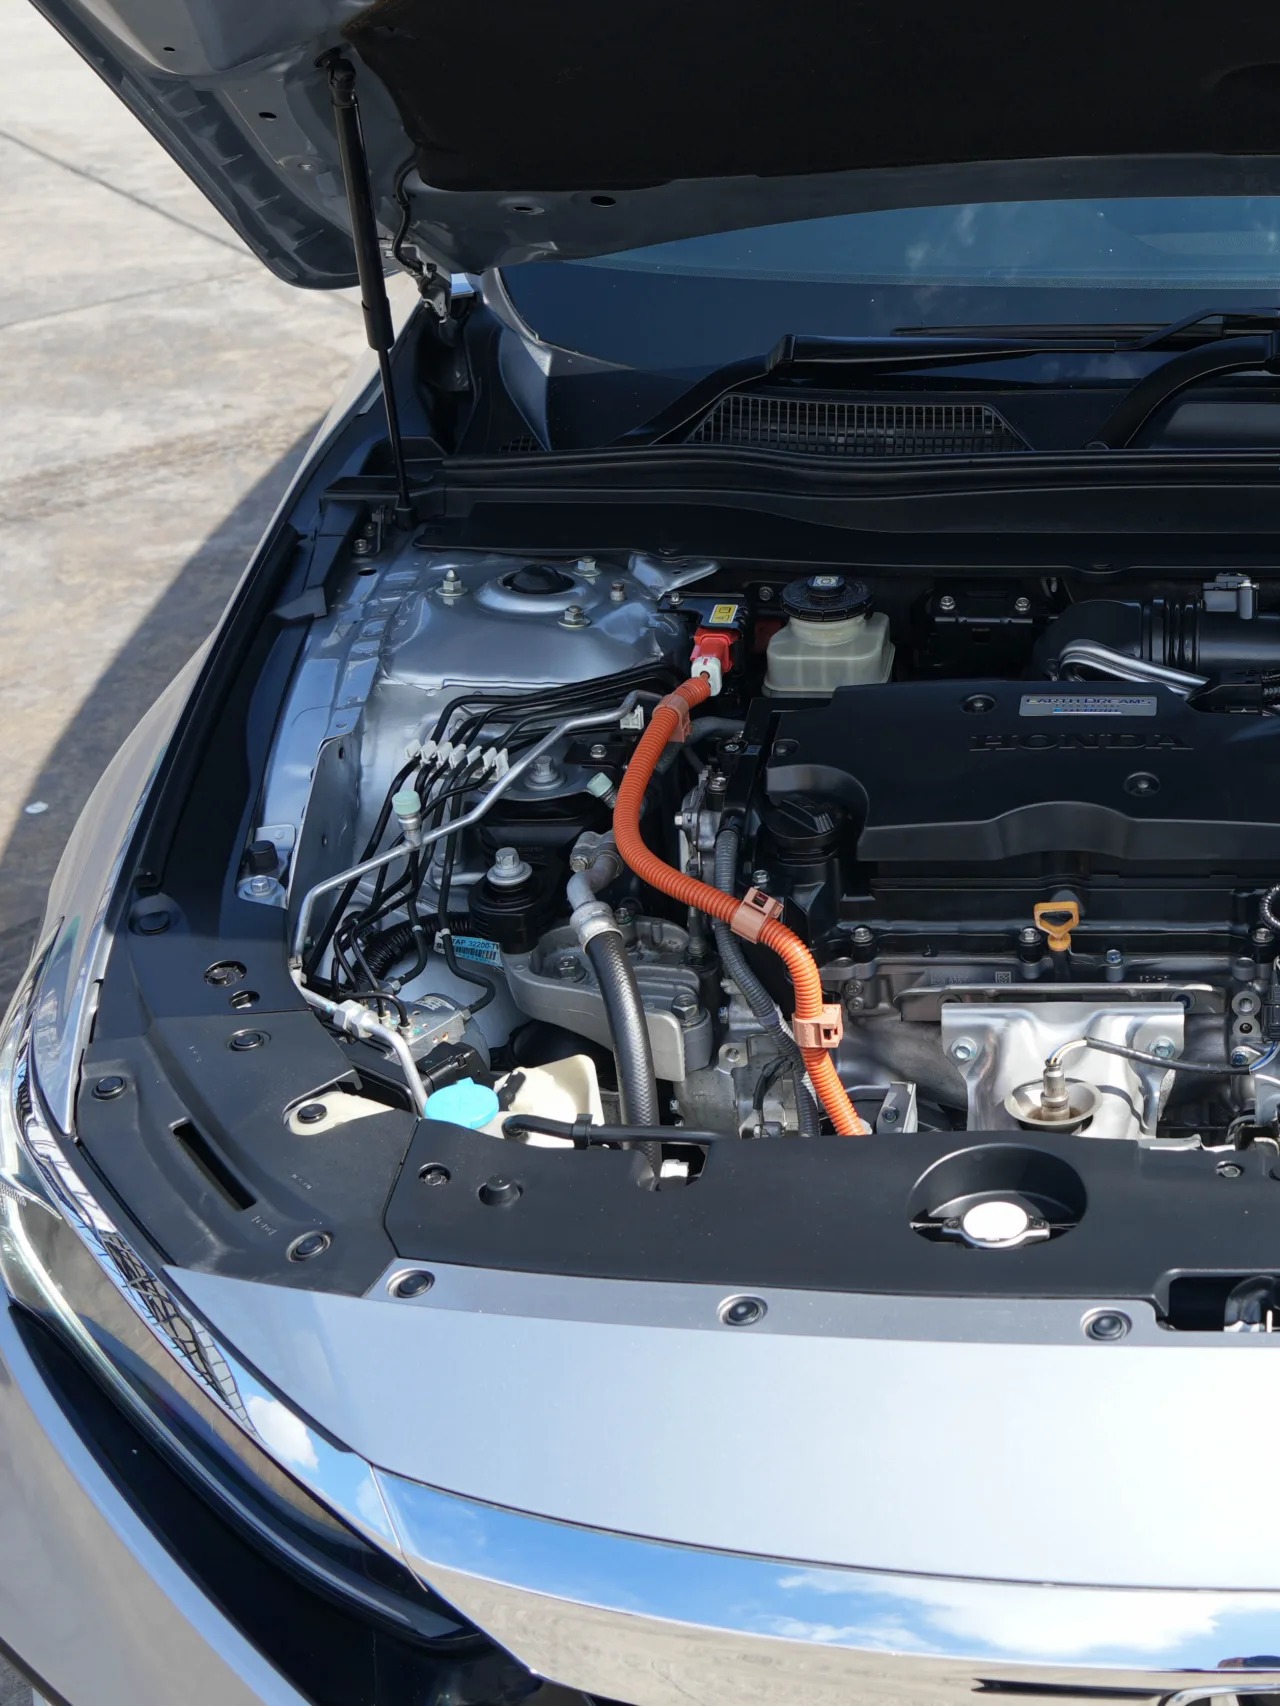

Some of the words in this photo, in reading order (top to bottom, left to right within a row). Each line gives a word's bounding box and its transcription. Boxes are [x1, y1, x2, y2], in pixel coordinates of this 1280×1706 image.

[1026, 697, 1080, 705] EARTH
[1084, 697, 1151, 705] DREAMS
[969, 733, 1194, 751] HONDA
